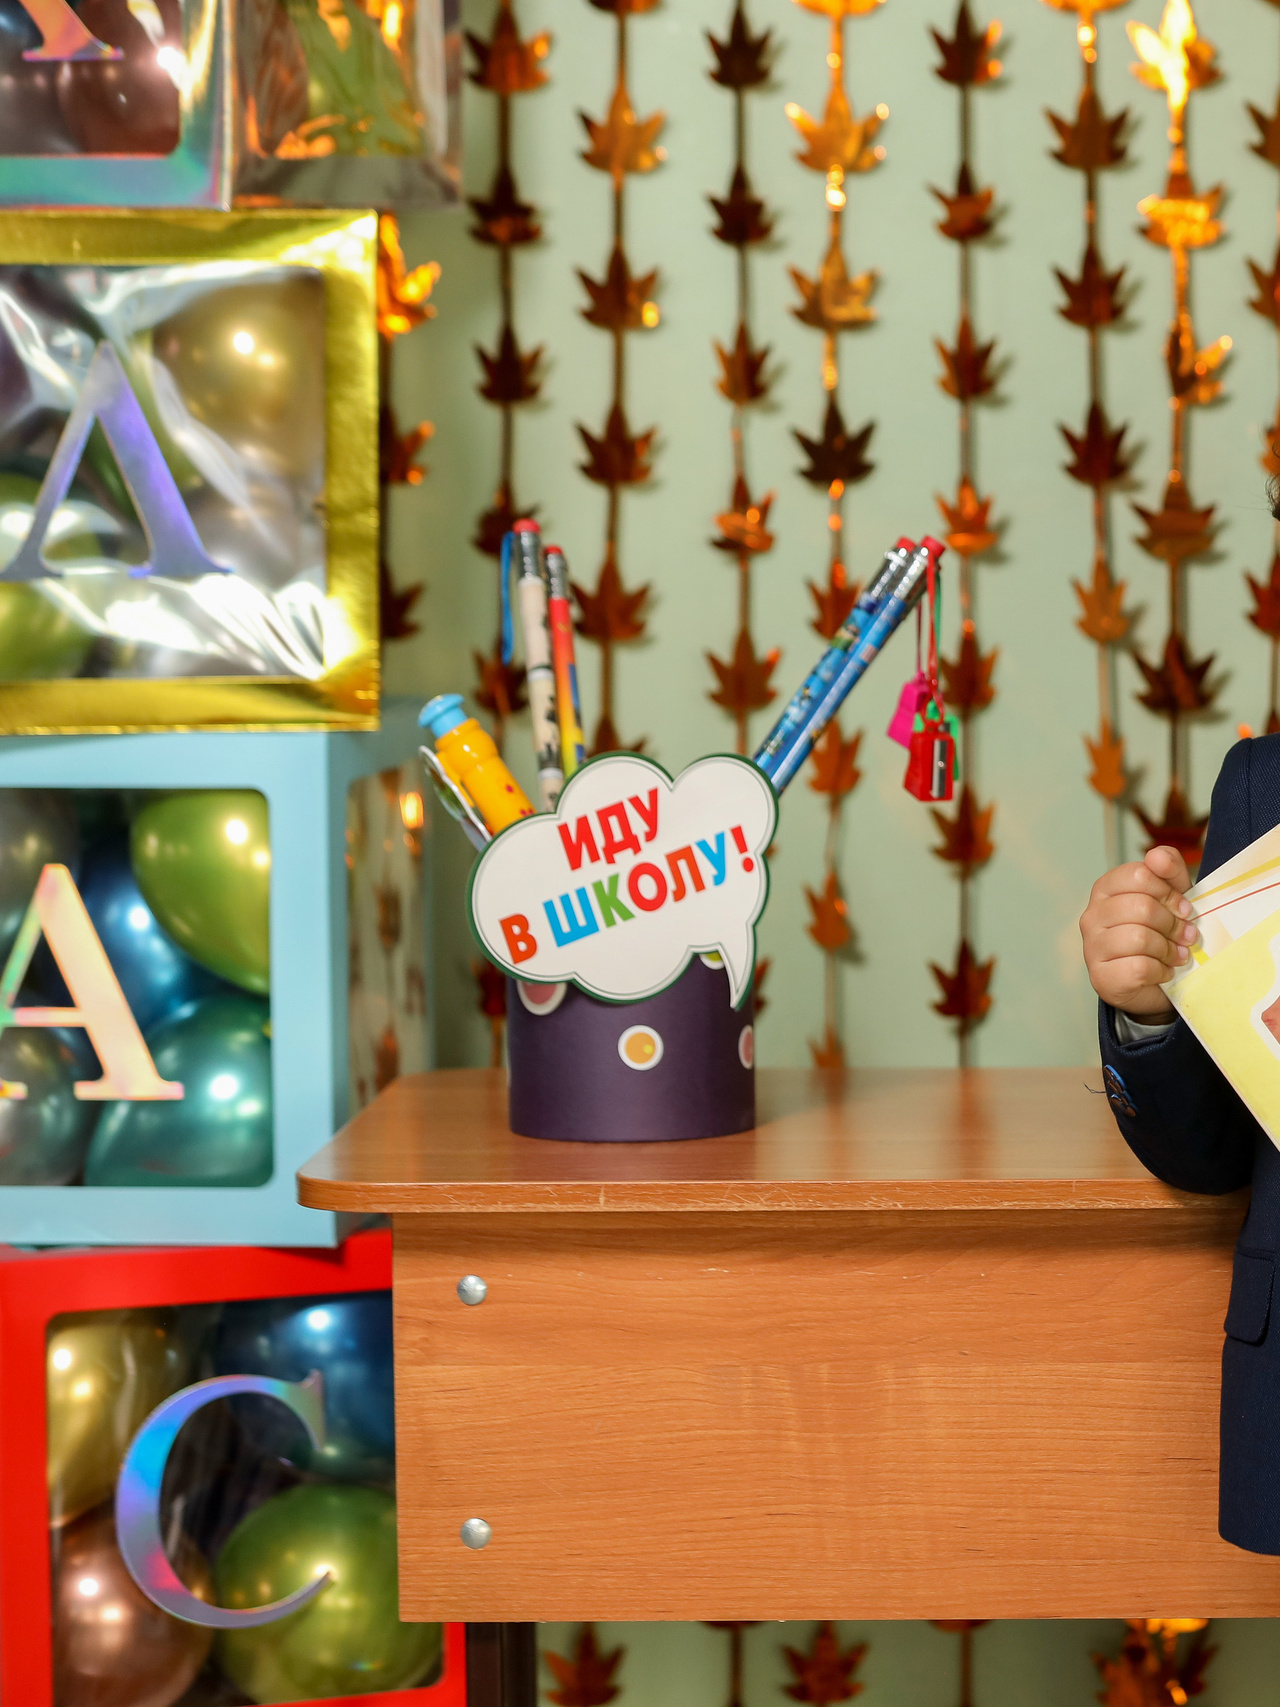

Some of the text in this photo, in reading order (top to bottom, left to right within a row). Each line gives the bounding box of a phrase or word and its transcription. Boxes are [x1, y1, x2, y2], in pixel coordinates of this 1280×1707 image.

[557, 786, 660, 871] ИДУ
[499, 824, 755, 966] В ШКОЛУ!
